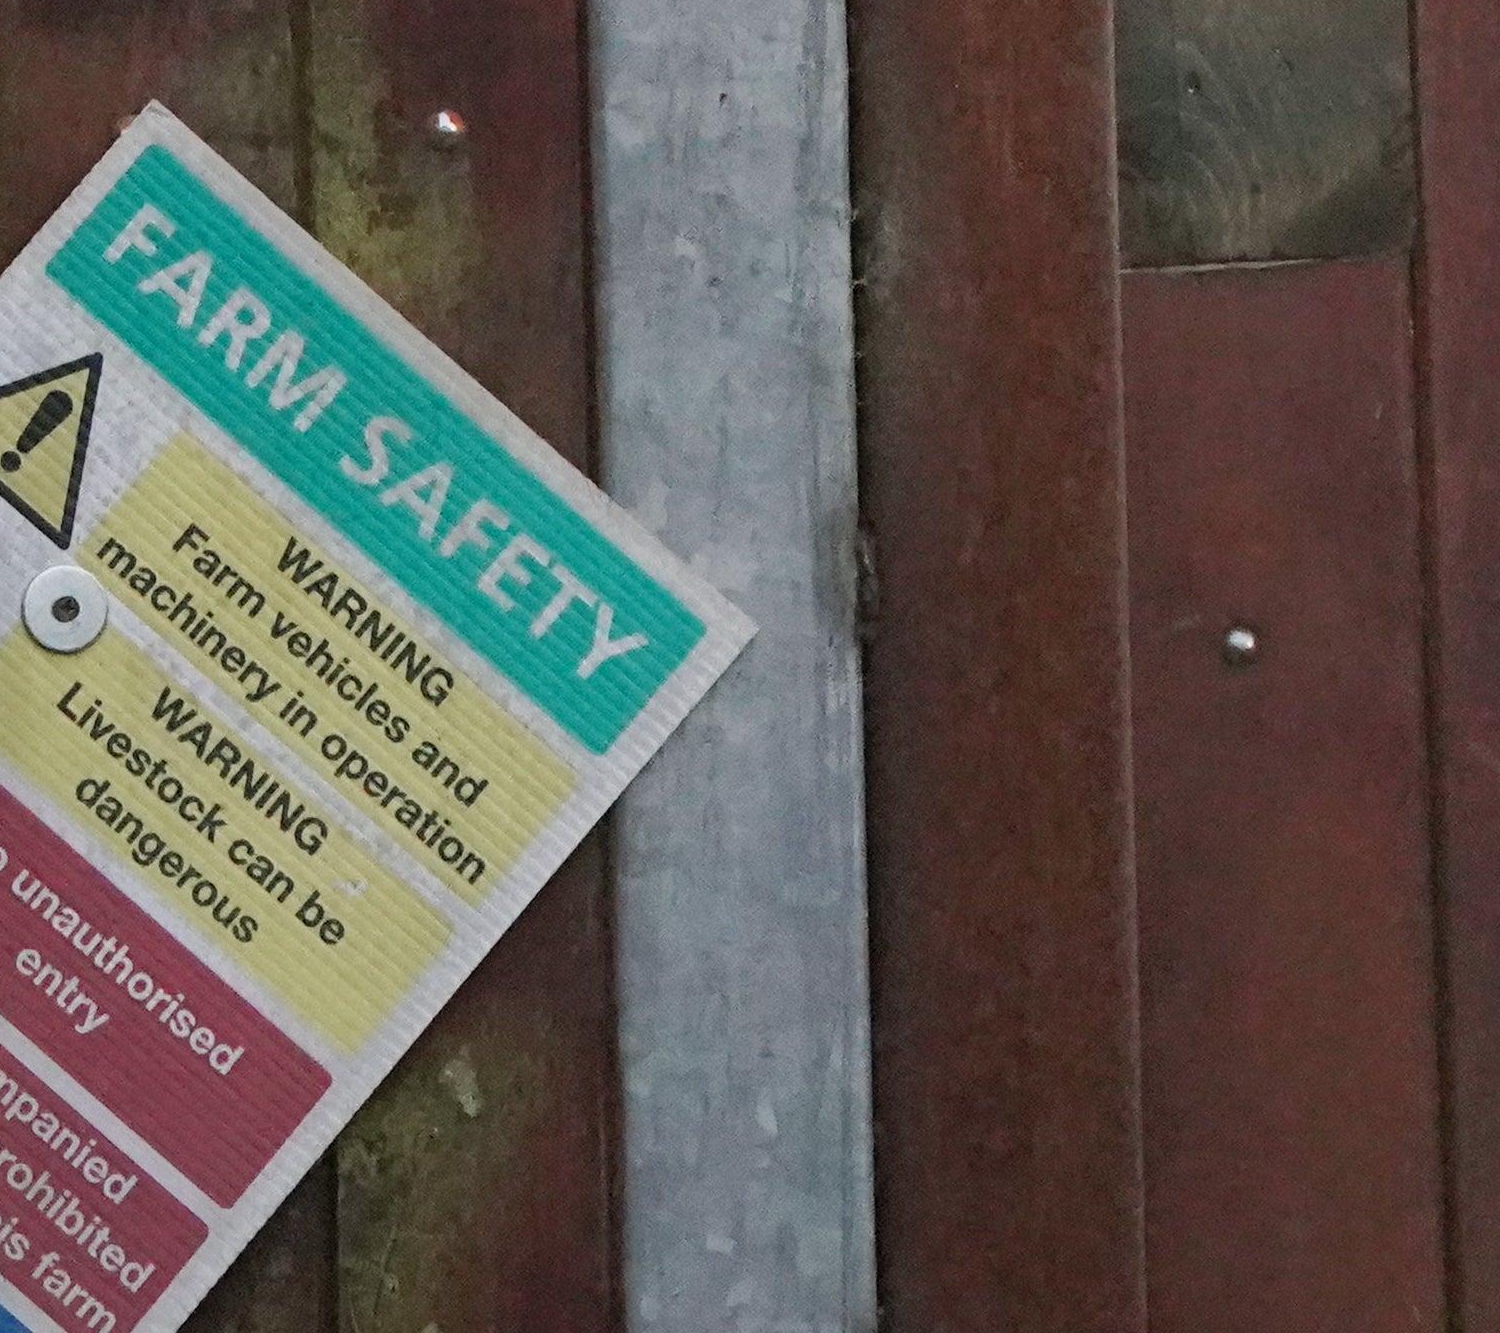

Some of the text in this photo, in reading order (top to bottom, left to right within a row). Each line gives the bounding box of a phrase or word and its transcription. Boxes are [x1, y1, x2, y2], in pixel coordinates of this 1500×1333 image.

[102, 202, 650, 680] FARM SAFETY
[96, 536, 488, 886] machinery in operation
[171, 522, 490, 809] Farm vehicles and
[276, 536, 455, 708] WARNING
[55, 680, 347, 947] Livestock can be
[74, 776, 261, 945] dangerous
[151, 685, 330, 857] WARNING
[11, 869, 246, 1077] unauthorised
[13, 945, 112, 1036] entry
[31, 1251, 117, 1333] farm
